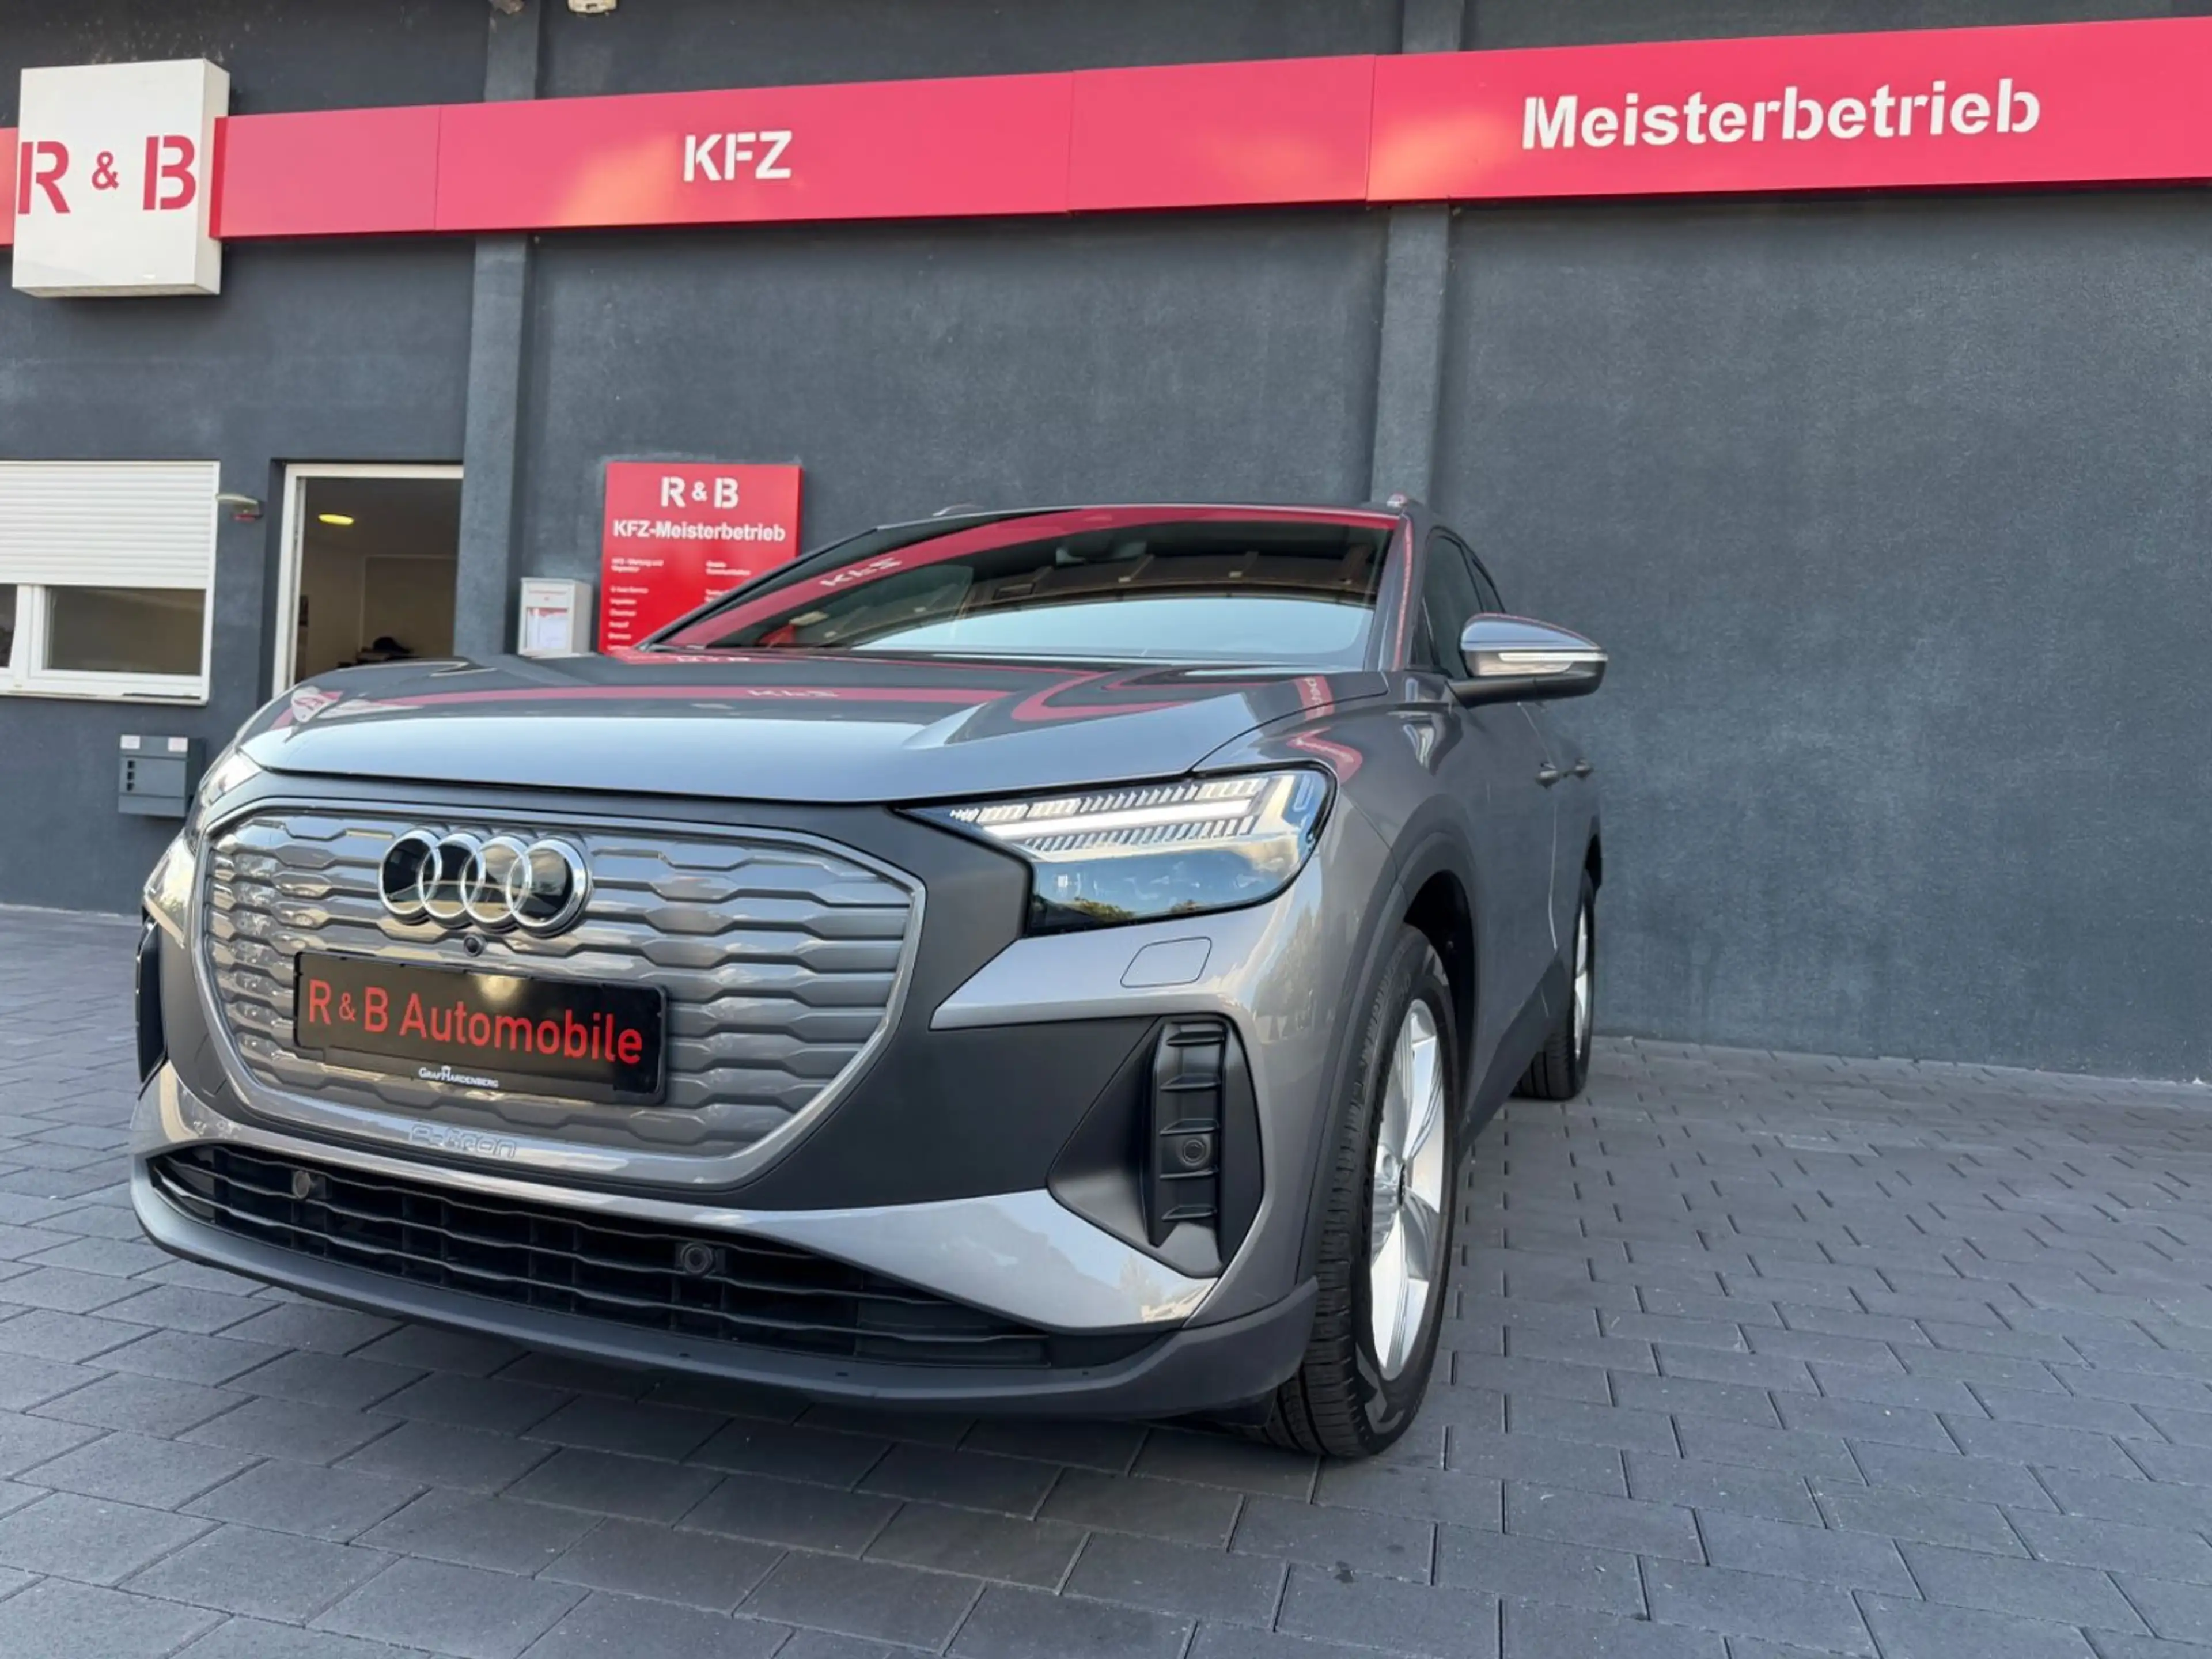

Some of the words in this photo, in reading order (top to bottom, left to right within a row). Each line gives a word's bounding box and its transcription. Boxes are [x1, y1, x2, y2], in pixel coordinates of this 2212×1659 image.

[683, 130, 793, 183] KFZ
[1522, 78, 2040, 149] Meisterbetrieb
[18, 141, 71, 215] R
[91, 151, 119, 190] &
[142, 135, 196, 210] B
[612, 519, 786, 541] KFZ-Meisterbetrieb
[660, 476, 687, 508] R
[691, 481, 708, 502] &
[713, 476, 740, 509] B
[308, 979, 332, 1025] R
[338, 991, 357, 1022] &
[363, 985, 389, 1033] B
[399, 991, 643, 1065] Automobile
